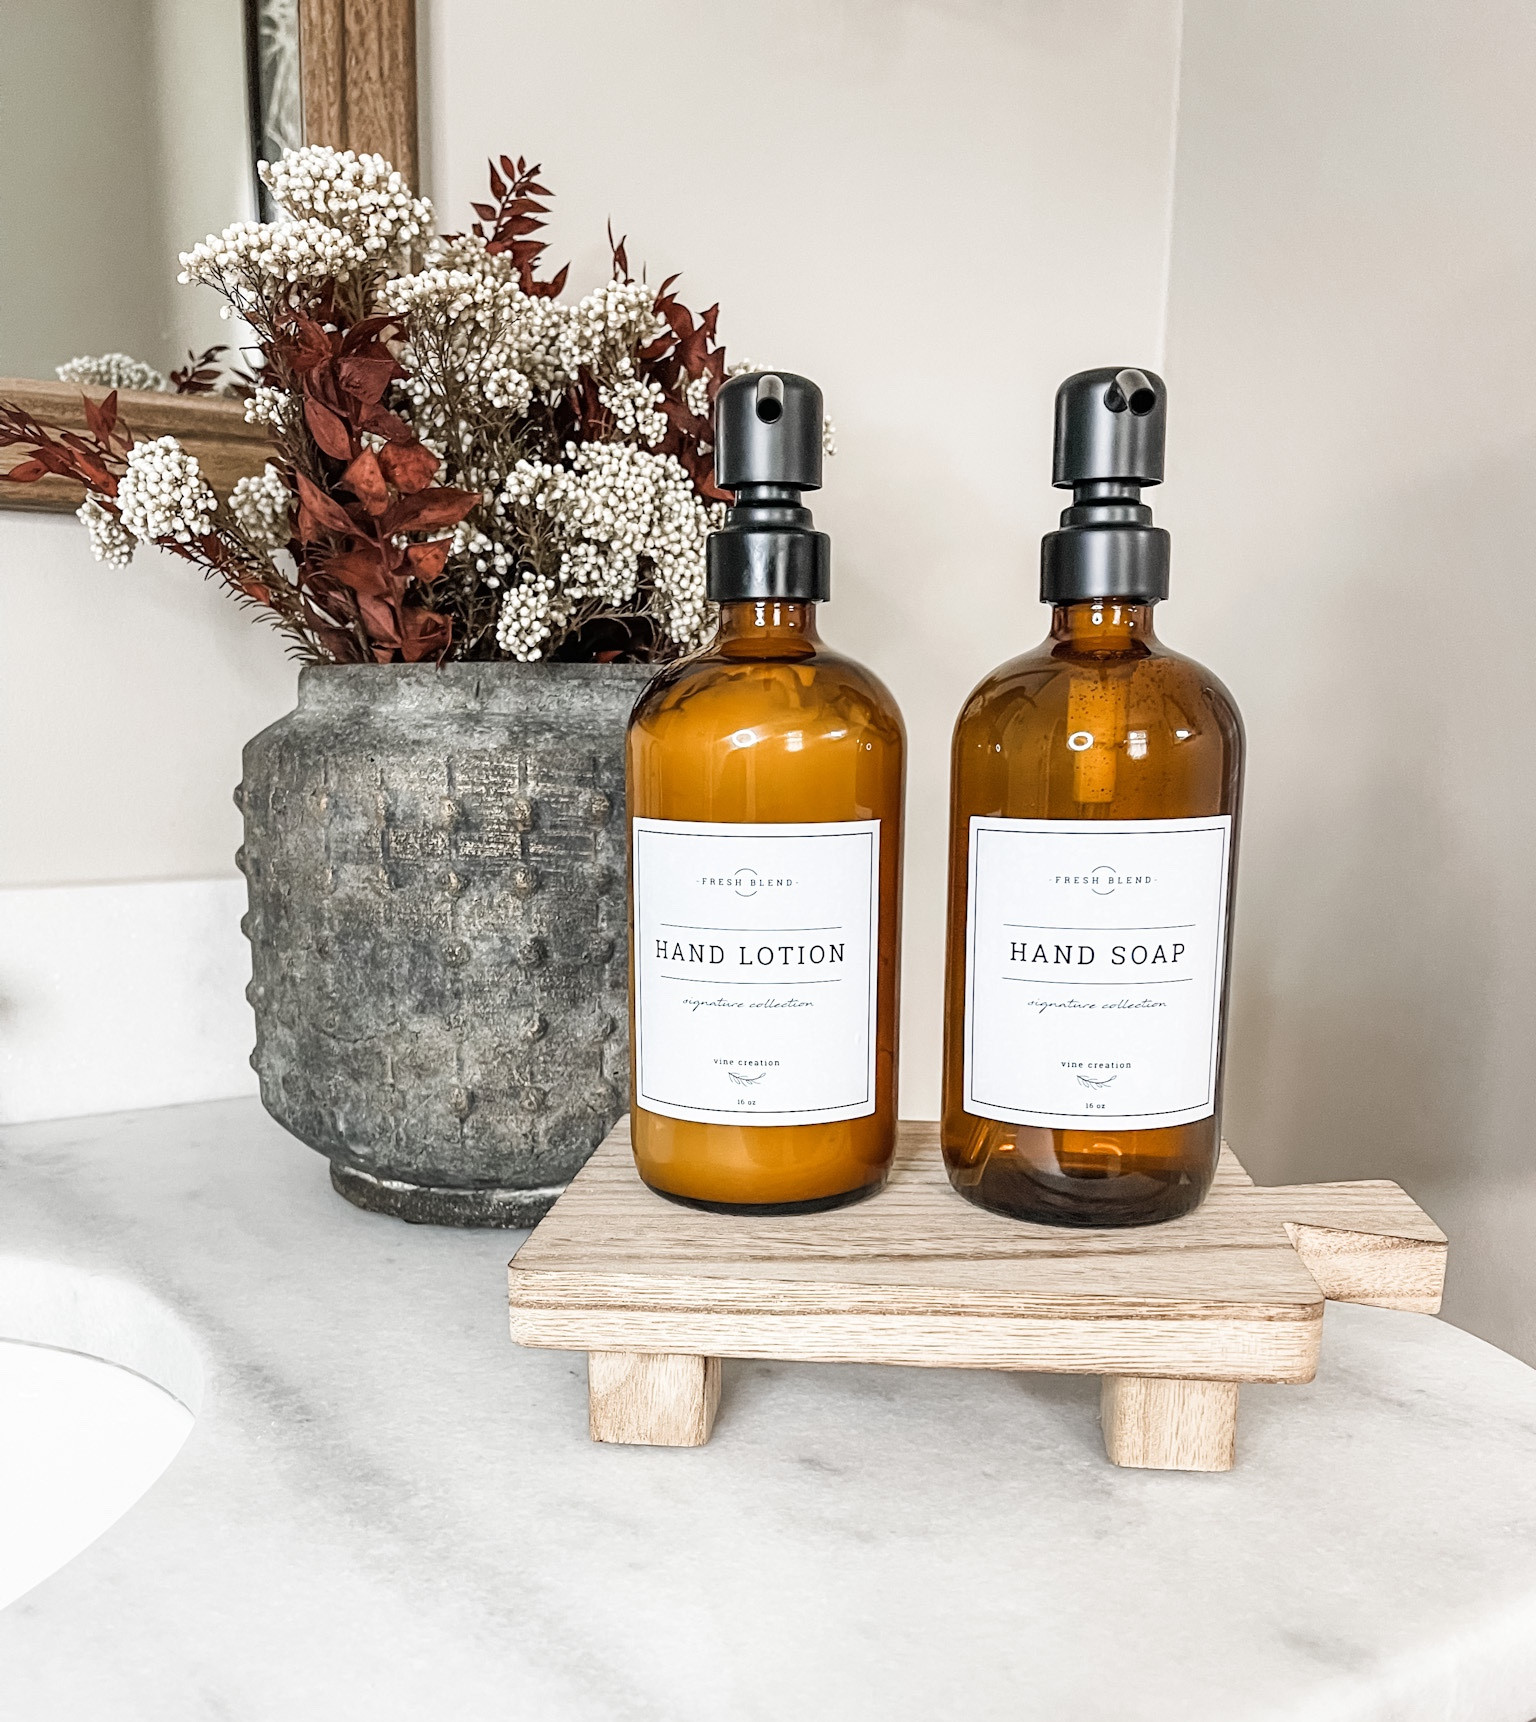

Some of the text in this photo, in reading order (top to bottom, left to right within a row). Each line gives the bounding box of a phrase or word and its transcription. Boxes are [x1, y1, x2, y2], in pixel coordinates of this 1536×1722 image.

[655, 939, 846, 966] HAND LOTION
[1009, 941, 1185, 966] HAND SOAP
[682, 997, 814, 1012] signature collection
[1027, 998, 1167, 1015] signature collection
[713, 1058, 780, 1067] vine creation
[1060, 1061, 1084, 1069] vine
